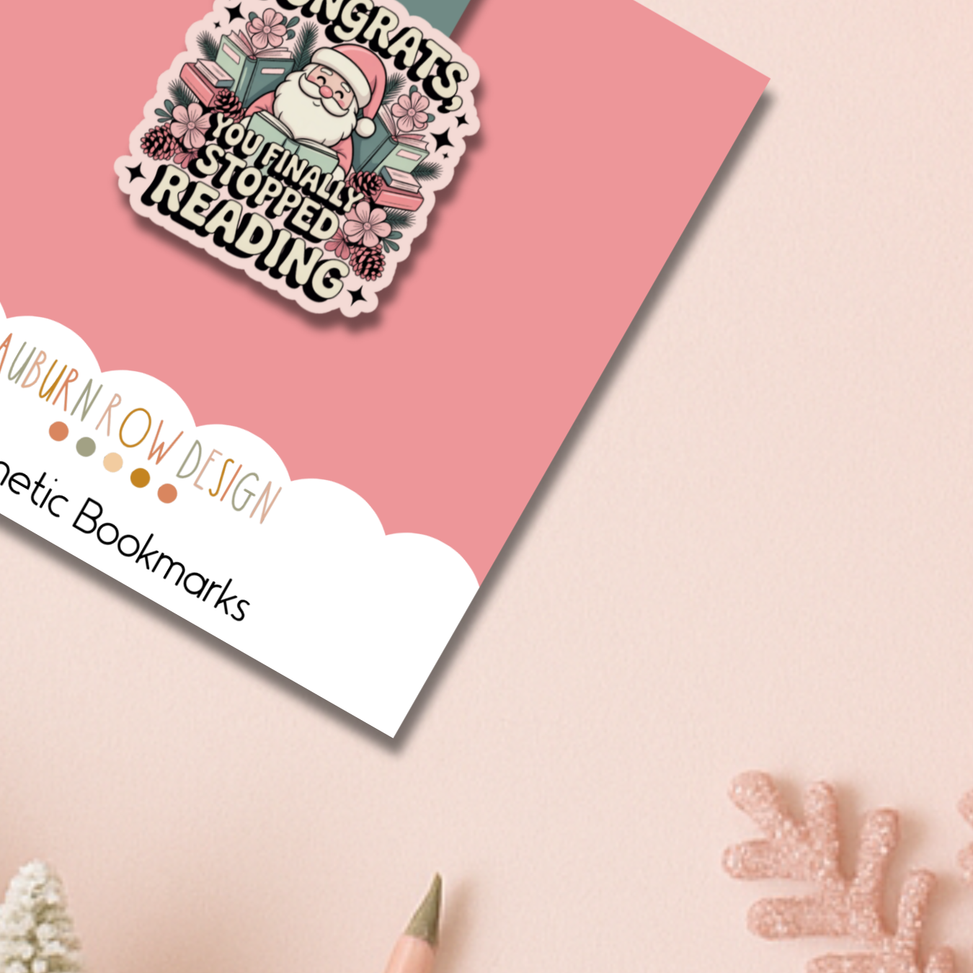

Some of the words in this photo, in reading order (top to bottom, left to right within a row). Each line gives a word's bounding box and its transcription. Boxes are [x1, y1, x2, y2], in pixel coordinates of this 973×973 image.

[190, 144, 339, 243] STOPPED
[208, 112, 264, 158] YOU
[256, 142, 364, 215] FINALLY
[141, 164, 350, 302] READING
[94, 392, 185, 466] ROW
[175, 439, 283, 525] DESIGN
[72, 497, 251, 622] Bookmarks
